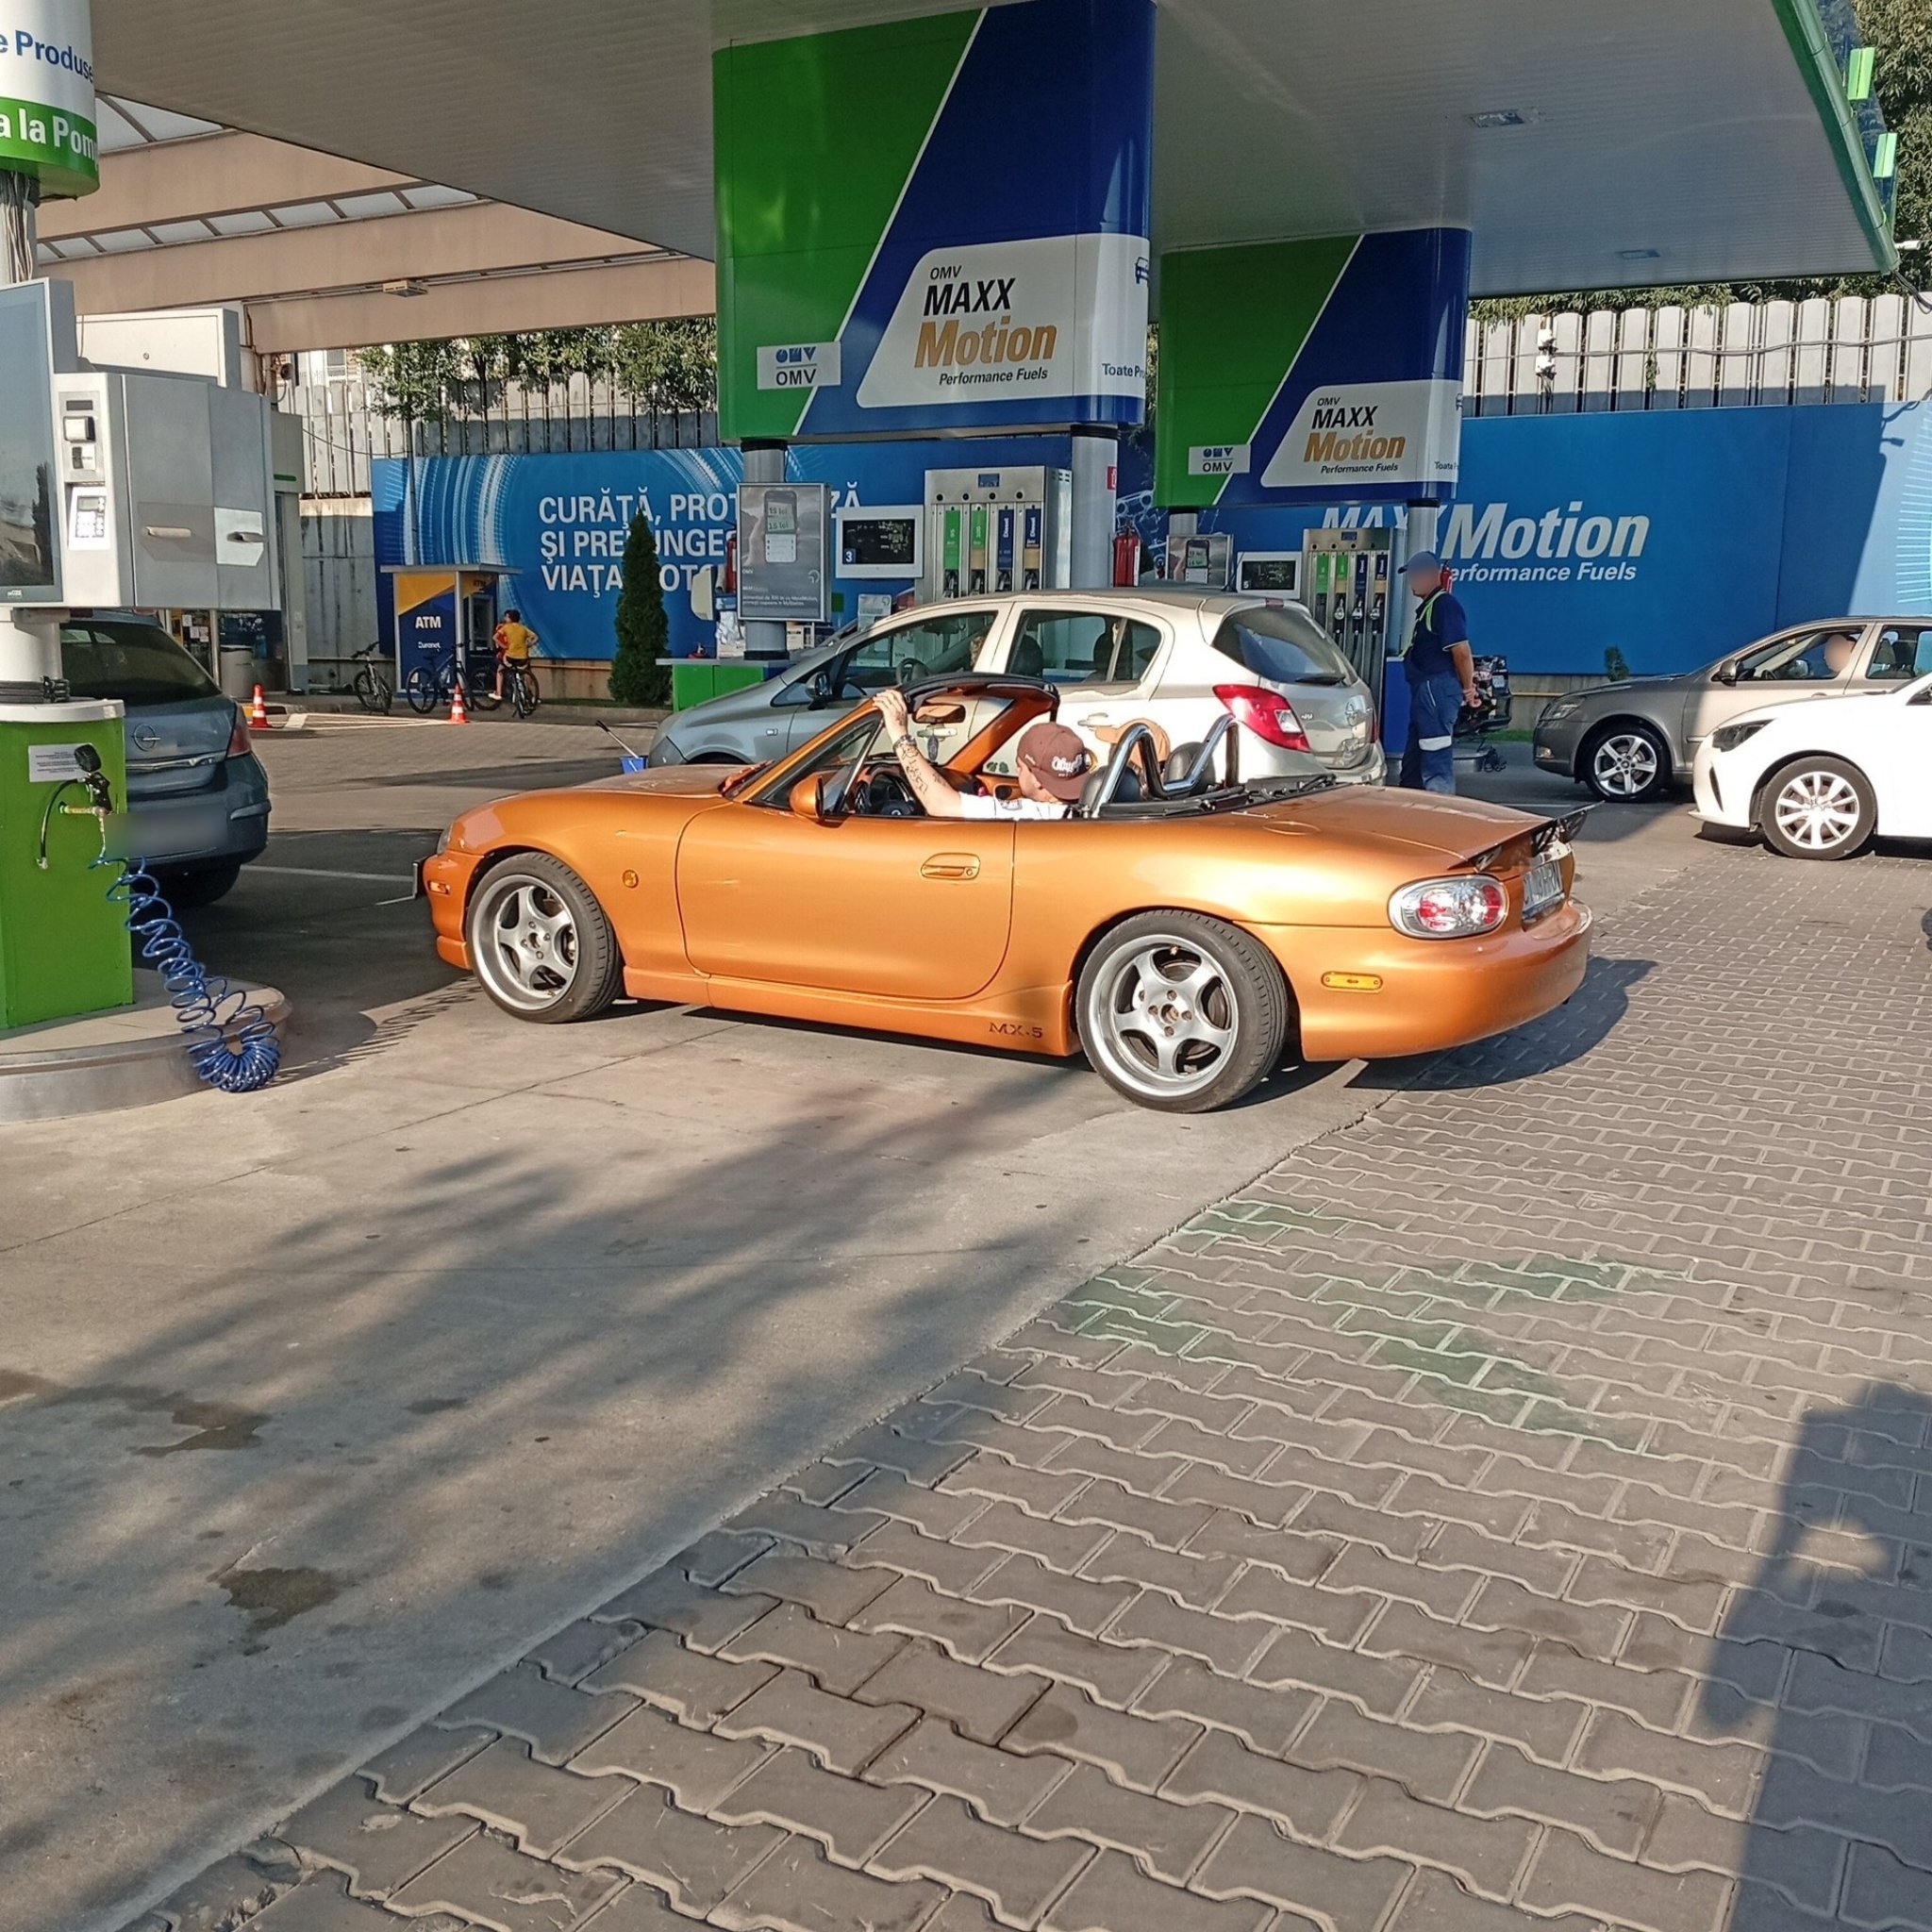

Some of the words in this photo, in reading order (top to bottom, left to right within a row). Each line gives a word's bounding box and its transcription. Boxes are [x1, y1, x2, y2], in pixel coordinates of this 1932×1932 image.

[18, 108, 46, 144] la
[52, 115, 96, 160] Pom
[930, 265, 962, 280] OMV
[924, 277, 1016, 316] MAXX
[914, 315, 1058, 369] Motion
[775, 369, 817, 386] OMV
[939, 372, 1013, 386] Performance
[1016, 366, 1049, 381] Fuels
[1102, 363, 1133, 377] Toate
[1317, 397, 1341, 407] OMV
[1311, 406, 1378, 429] MAXX
[1304, 428, 1407, 462] Motion
[1202, 461, 1233, 473] OMV
[1321, 464, 1374, 474] Performance
[1375, 461, 1398, 472] Fuels
[1440, 501, 1650, 559] Motion
[845, 551, 853, 562] 3
[1451, 563, 1571, 581] erformance
[1576, 561, 1637, 580] Fuels
[415, 616, 441, 628] ATM
